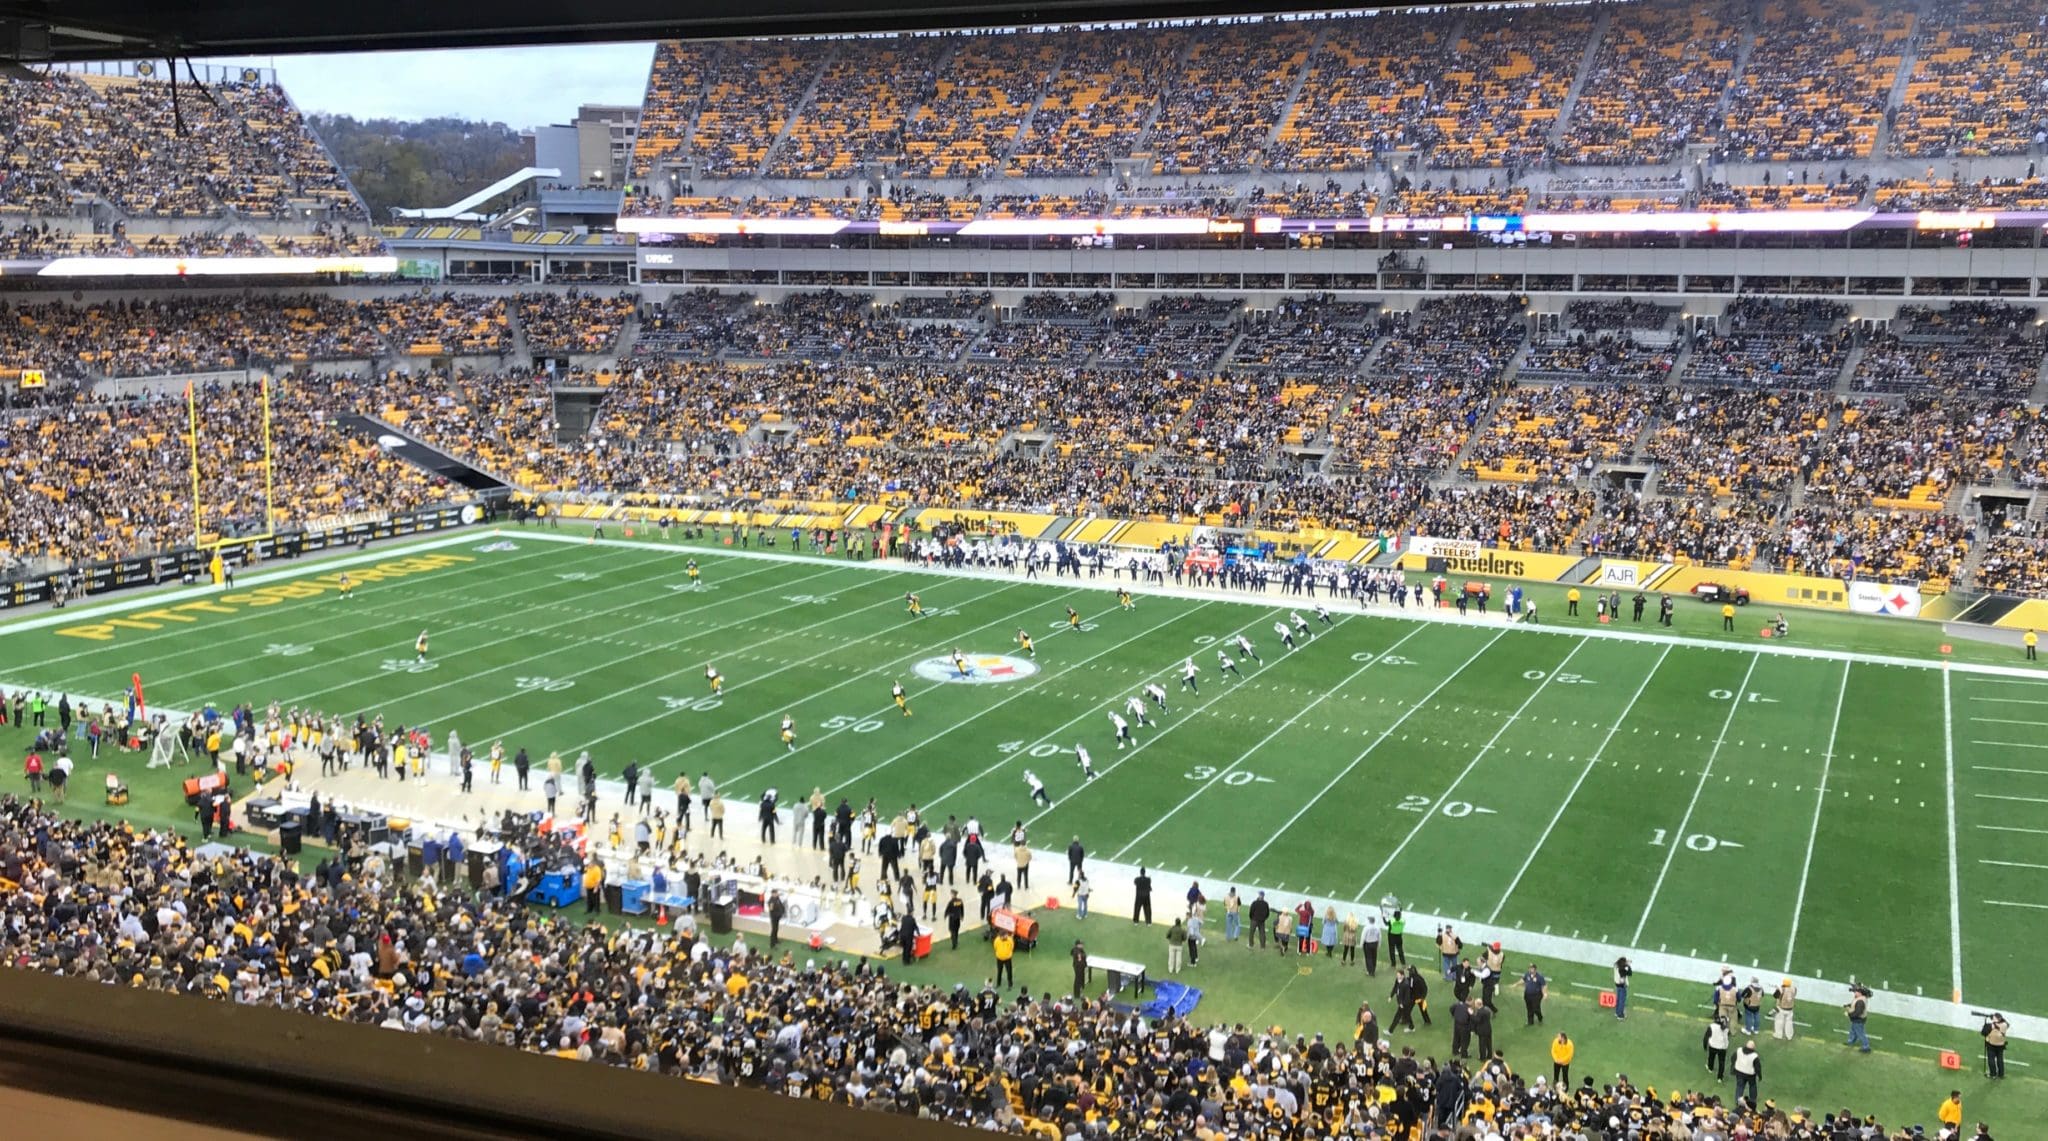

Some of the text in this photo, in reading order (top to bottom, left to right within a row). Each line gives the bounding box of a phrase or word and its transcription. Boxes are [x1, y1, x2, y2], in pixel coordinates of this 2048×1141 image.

[646, 254, 673, 264] UPMC
[1432, 548, 1477, 559] STEELERS
[1433, 541, 1477, 550] AMAZING
[1446, 552, 1524, 576] Steelers
[1607, 567, 1634, 583] AJR
[55, 553, 476, 640] PITTSBURGH
[1858, 593, 1882, 602] Steelers
[1523, 669, 1583, 685] 20
[1708, 688, 1761, 703] 10
[820, 715, 884, 734] 50
[997, 740, 1060, 758] 40
[1184, 765, 1254, 787] 30
[1396, 794, 1472, 819] 20
[1648, 827, 1717, 853] 10
[1602, 994, 1614, 1005] 10
[919, 1015, 931, 1030] 19
[1946, 1055, 1955, 1066] G
